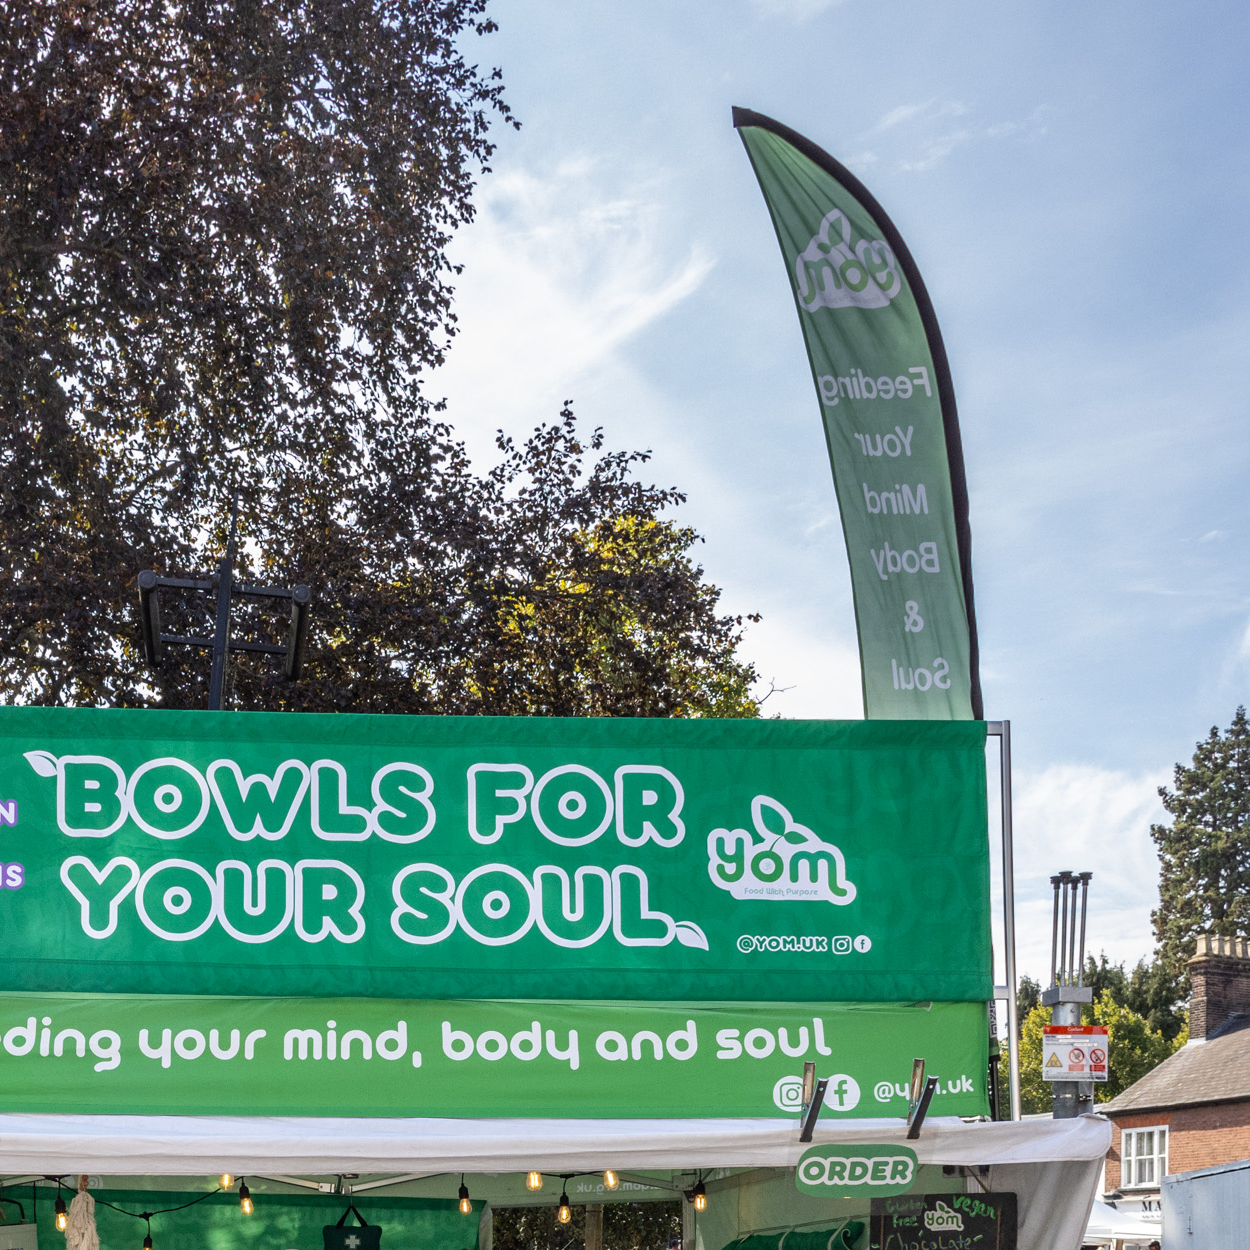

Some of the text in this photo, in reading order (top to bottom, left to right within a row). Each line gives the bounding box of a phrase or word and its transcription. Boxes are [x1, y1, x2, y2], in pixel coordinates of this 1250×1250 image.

[57, 755, 687, 849] BOWLS FOR
[714, 835, 848, 898] yom
[60, 855, 677, 950] YOUR SOUL
[744, 887, 764, 895] Food
[786, 888, 818, 896] Purpose
[737, 935, 827, 953] @YOM.UK
[138, 1026, 267, 1069] your
[283, 1021, 422, 1068] mind,
[441, 1020, 580, 1071] body
[594, 1019, 700, 1064] and
[715, 1017, 833, 1060] soul
[874, 1075, 974, 1102] @y.uk
[799, 1156, 914, 1185] ORDER
[926, 1213, 961, 1229] yom
